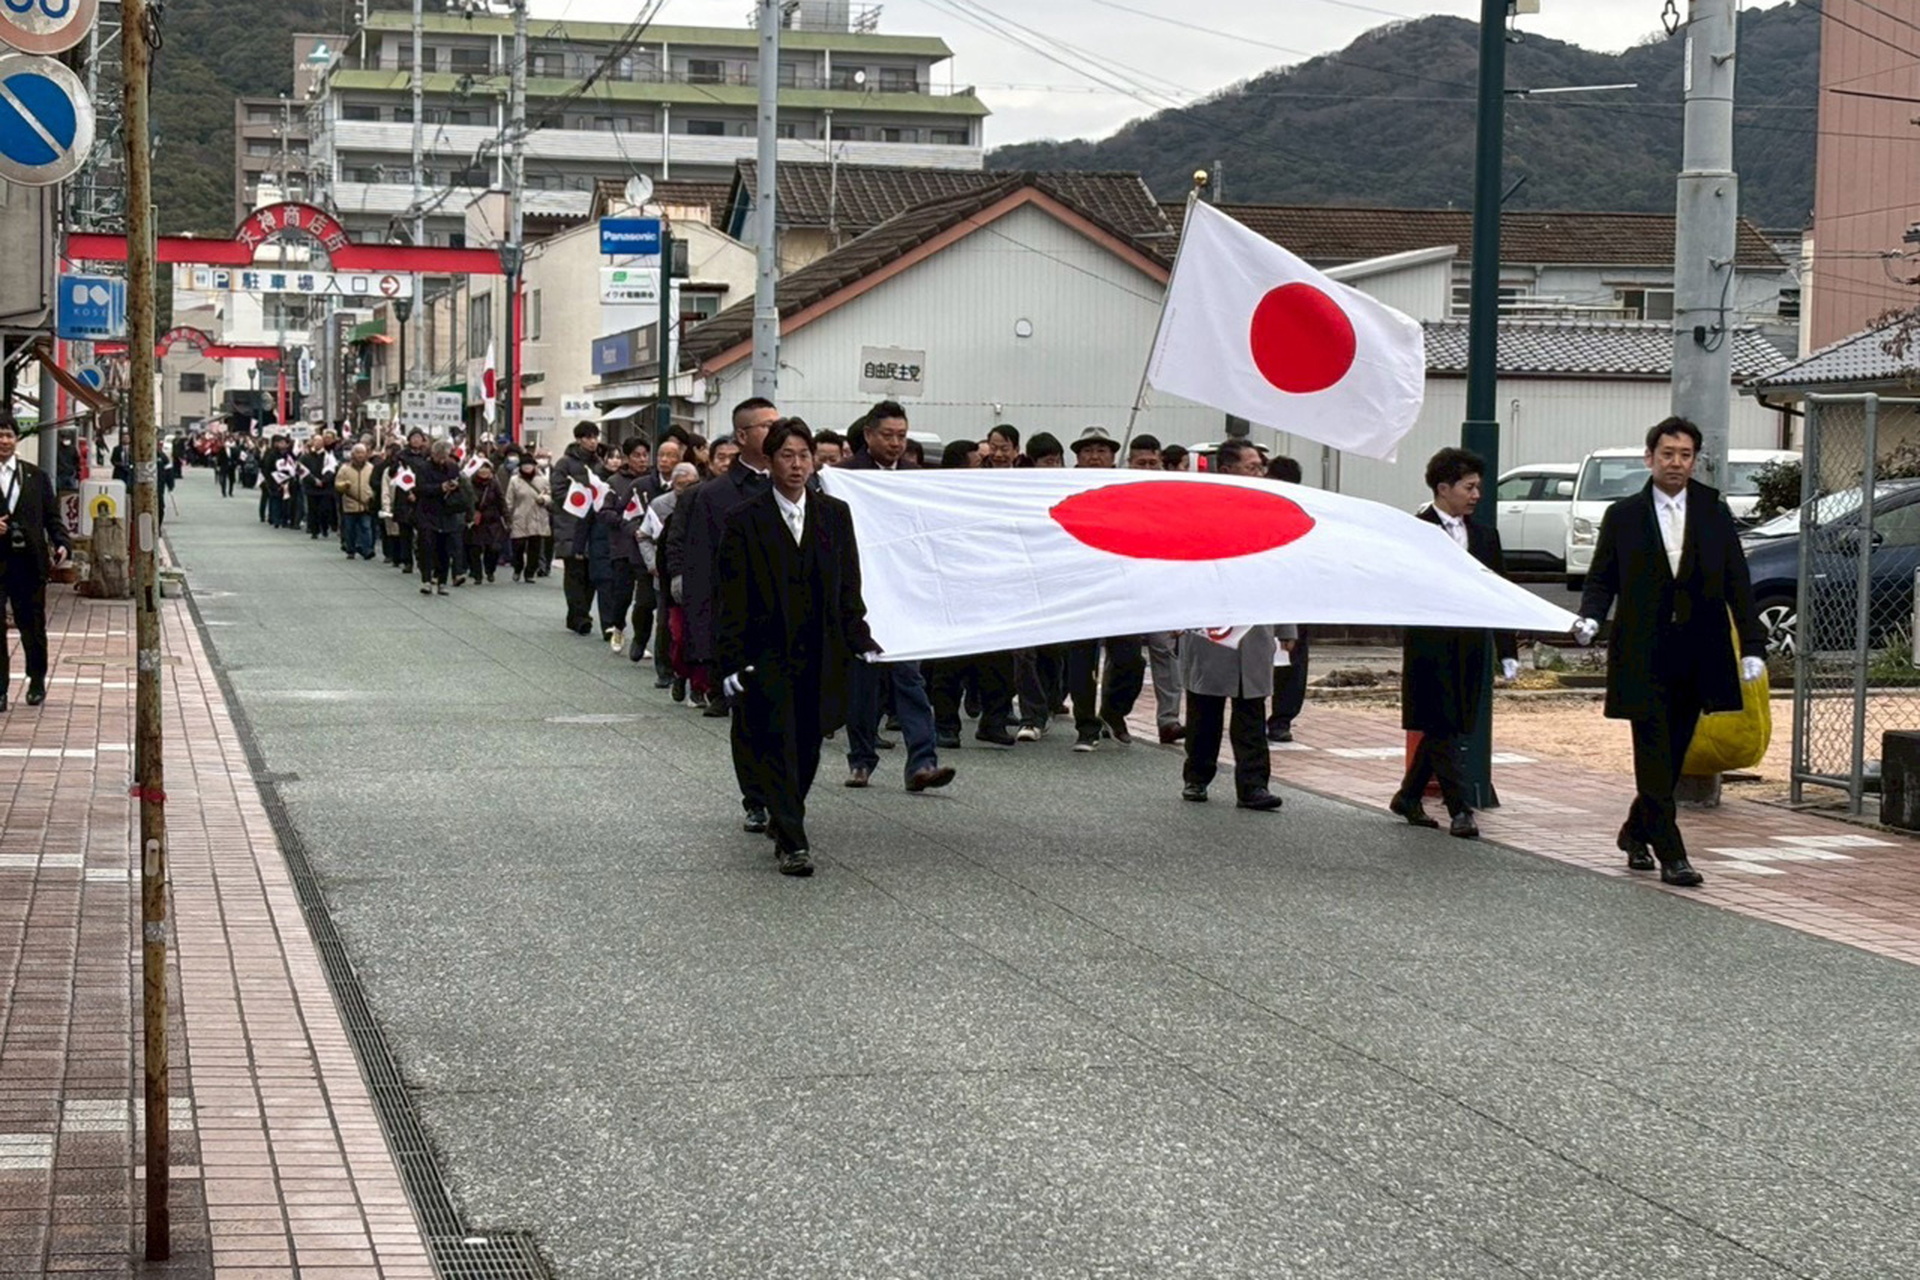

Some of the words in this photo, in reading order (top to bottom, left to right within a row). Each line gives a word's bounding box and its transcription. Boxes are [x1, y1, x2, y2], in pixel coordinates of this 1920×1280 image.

[236, 204, 350, 251] 天神商店街
[603, 231, 657, 241] Panasonic
[242, 271, 368, 293] 駐車場入口
[864, 361, 921, 382] 自由民主党
